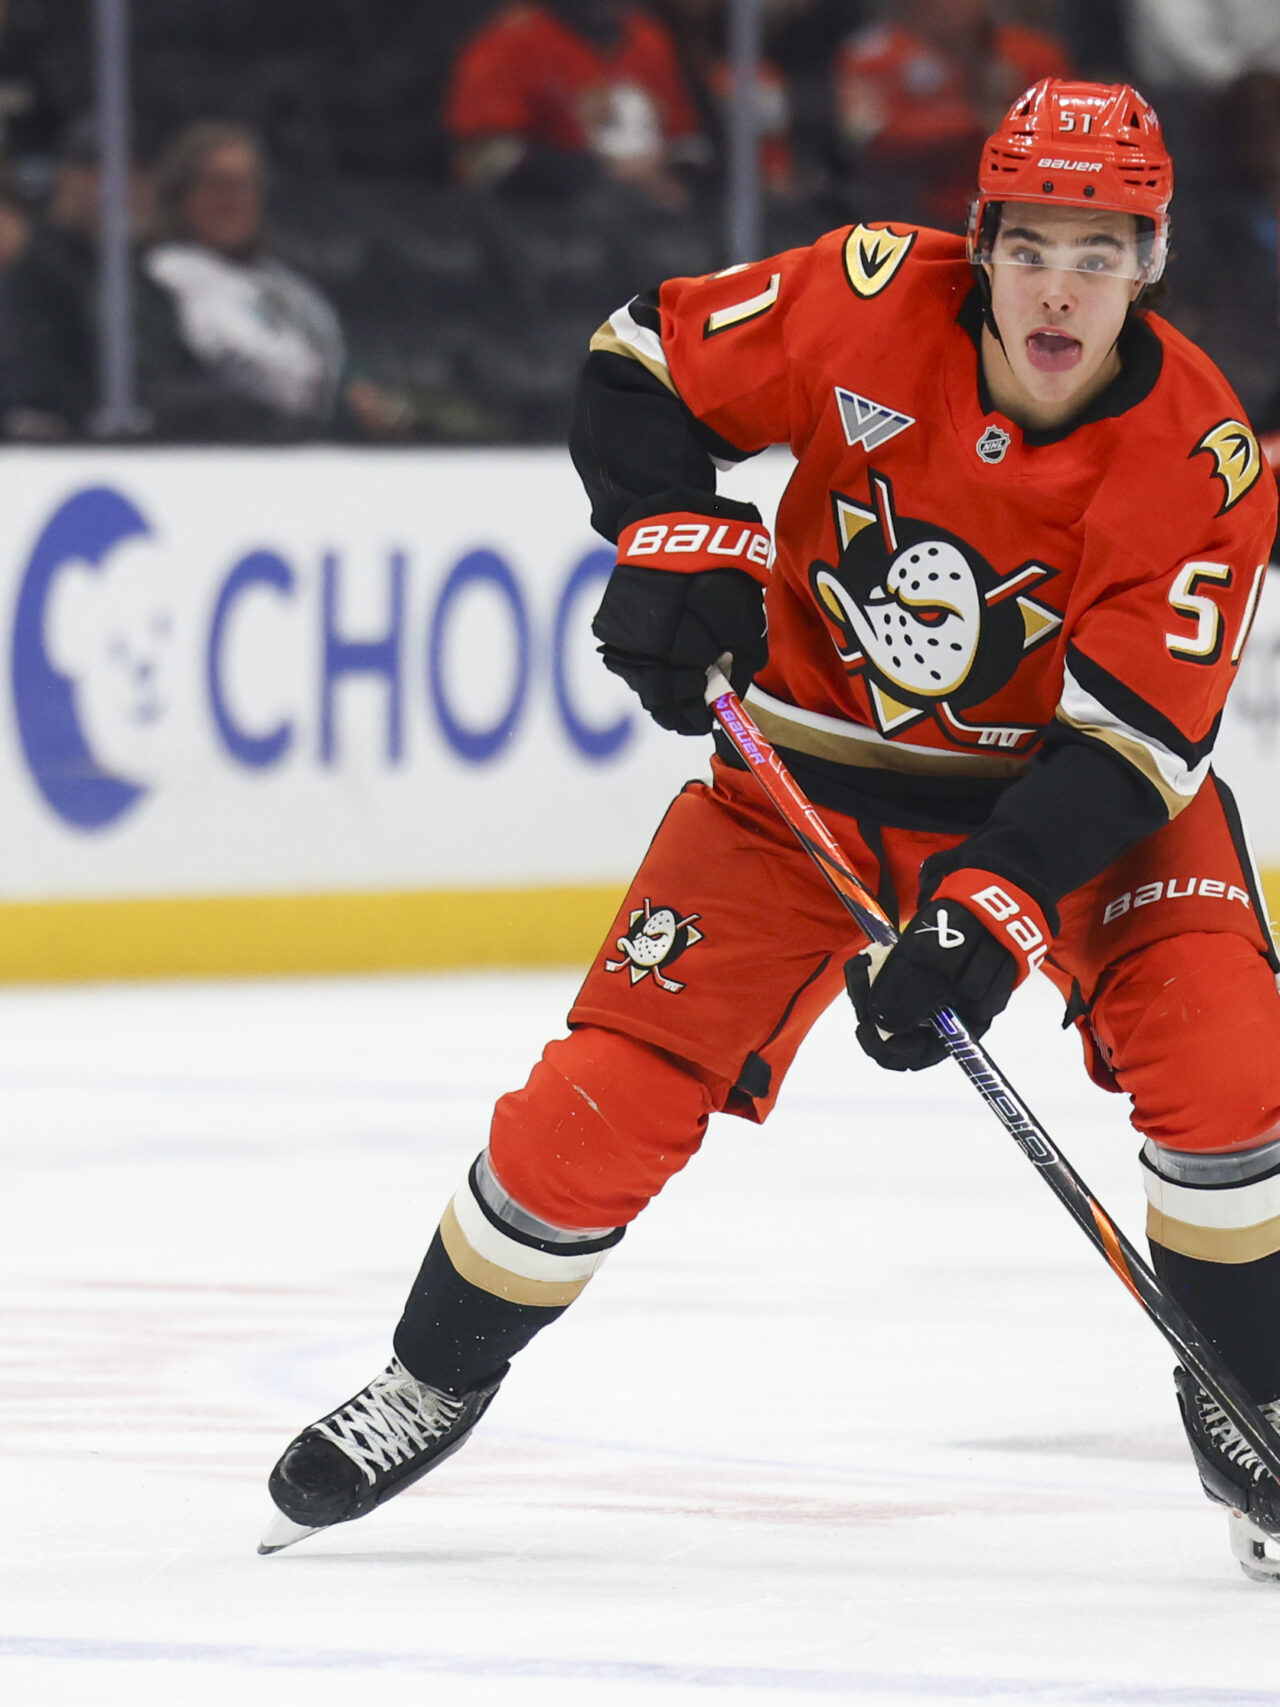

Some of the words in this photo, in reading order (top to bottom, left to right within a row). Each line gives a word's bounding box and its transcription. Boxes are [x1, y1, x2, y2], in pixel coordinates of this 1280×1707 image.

[1058, 111, 1093, 133] 51
[1036, 157, 1104, 173] BAUER
[206, 547, 637, 766] CHOC
[720, 709, 767, 765] BAUER
[1102, 877, 1251, 925] BAUER
[969, 885, 1048, 974] BAU
